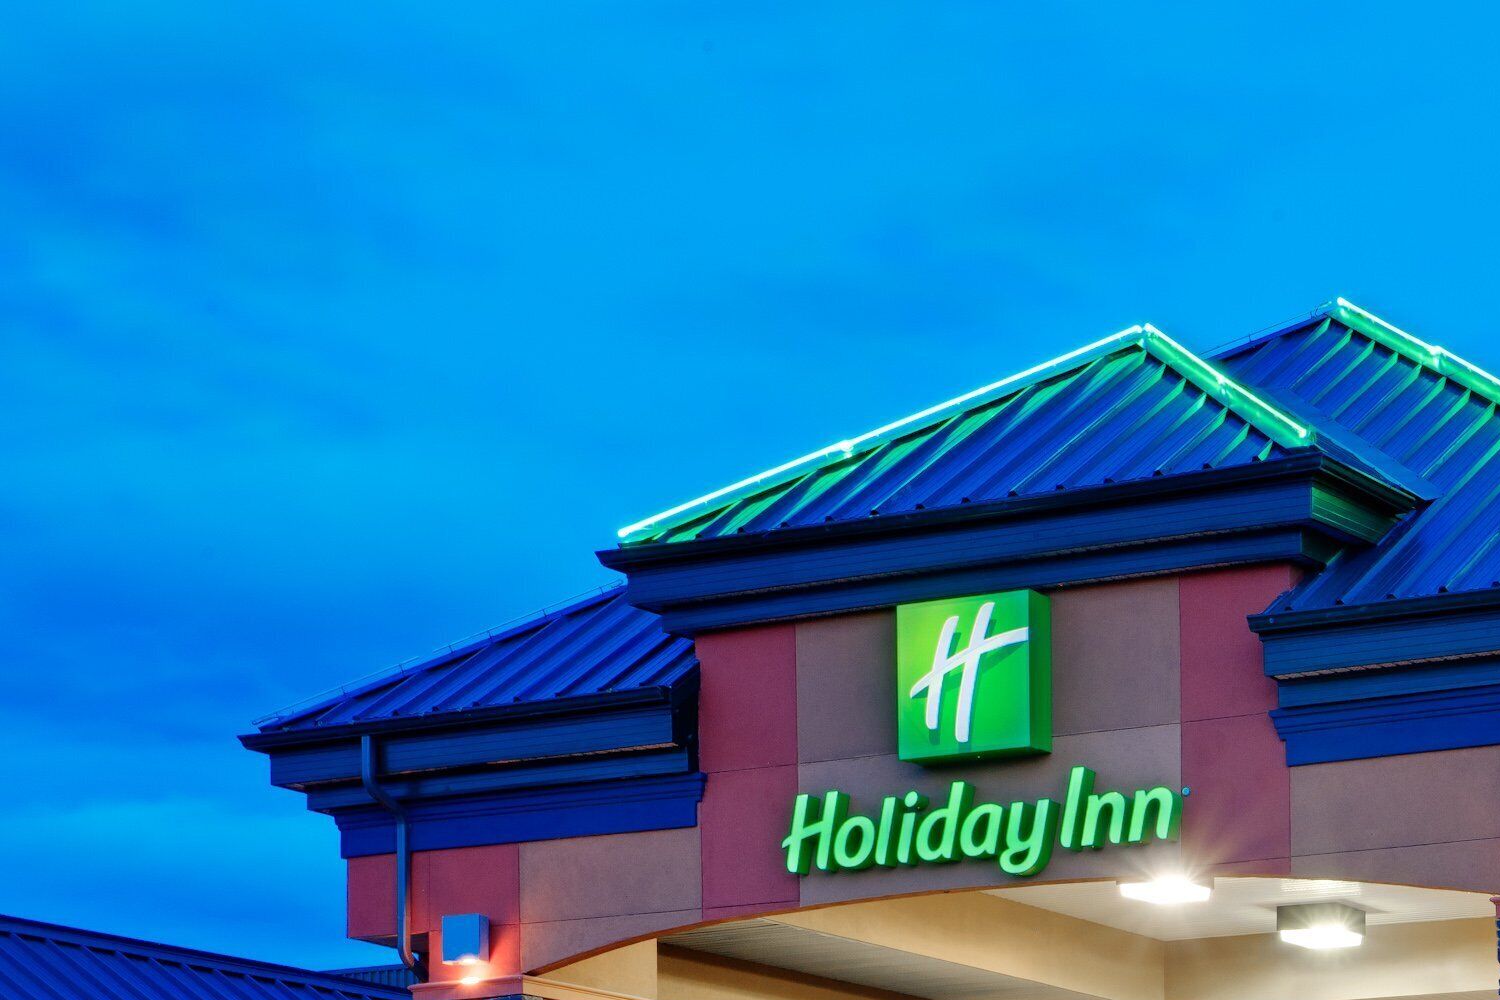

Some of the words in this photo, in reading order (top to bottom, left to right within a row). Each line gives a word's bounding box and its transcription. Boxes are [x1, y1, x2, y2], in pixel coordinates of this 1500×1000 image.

[910, 601, 1029, 743] H
[781, 780, 1057, 877] Holiday
[1060, 765, 1180, 849] Inn
